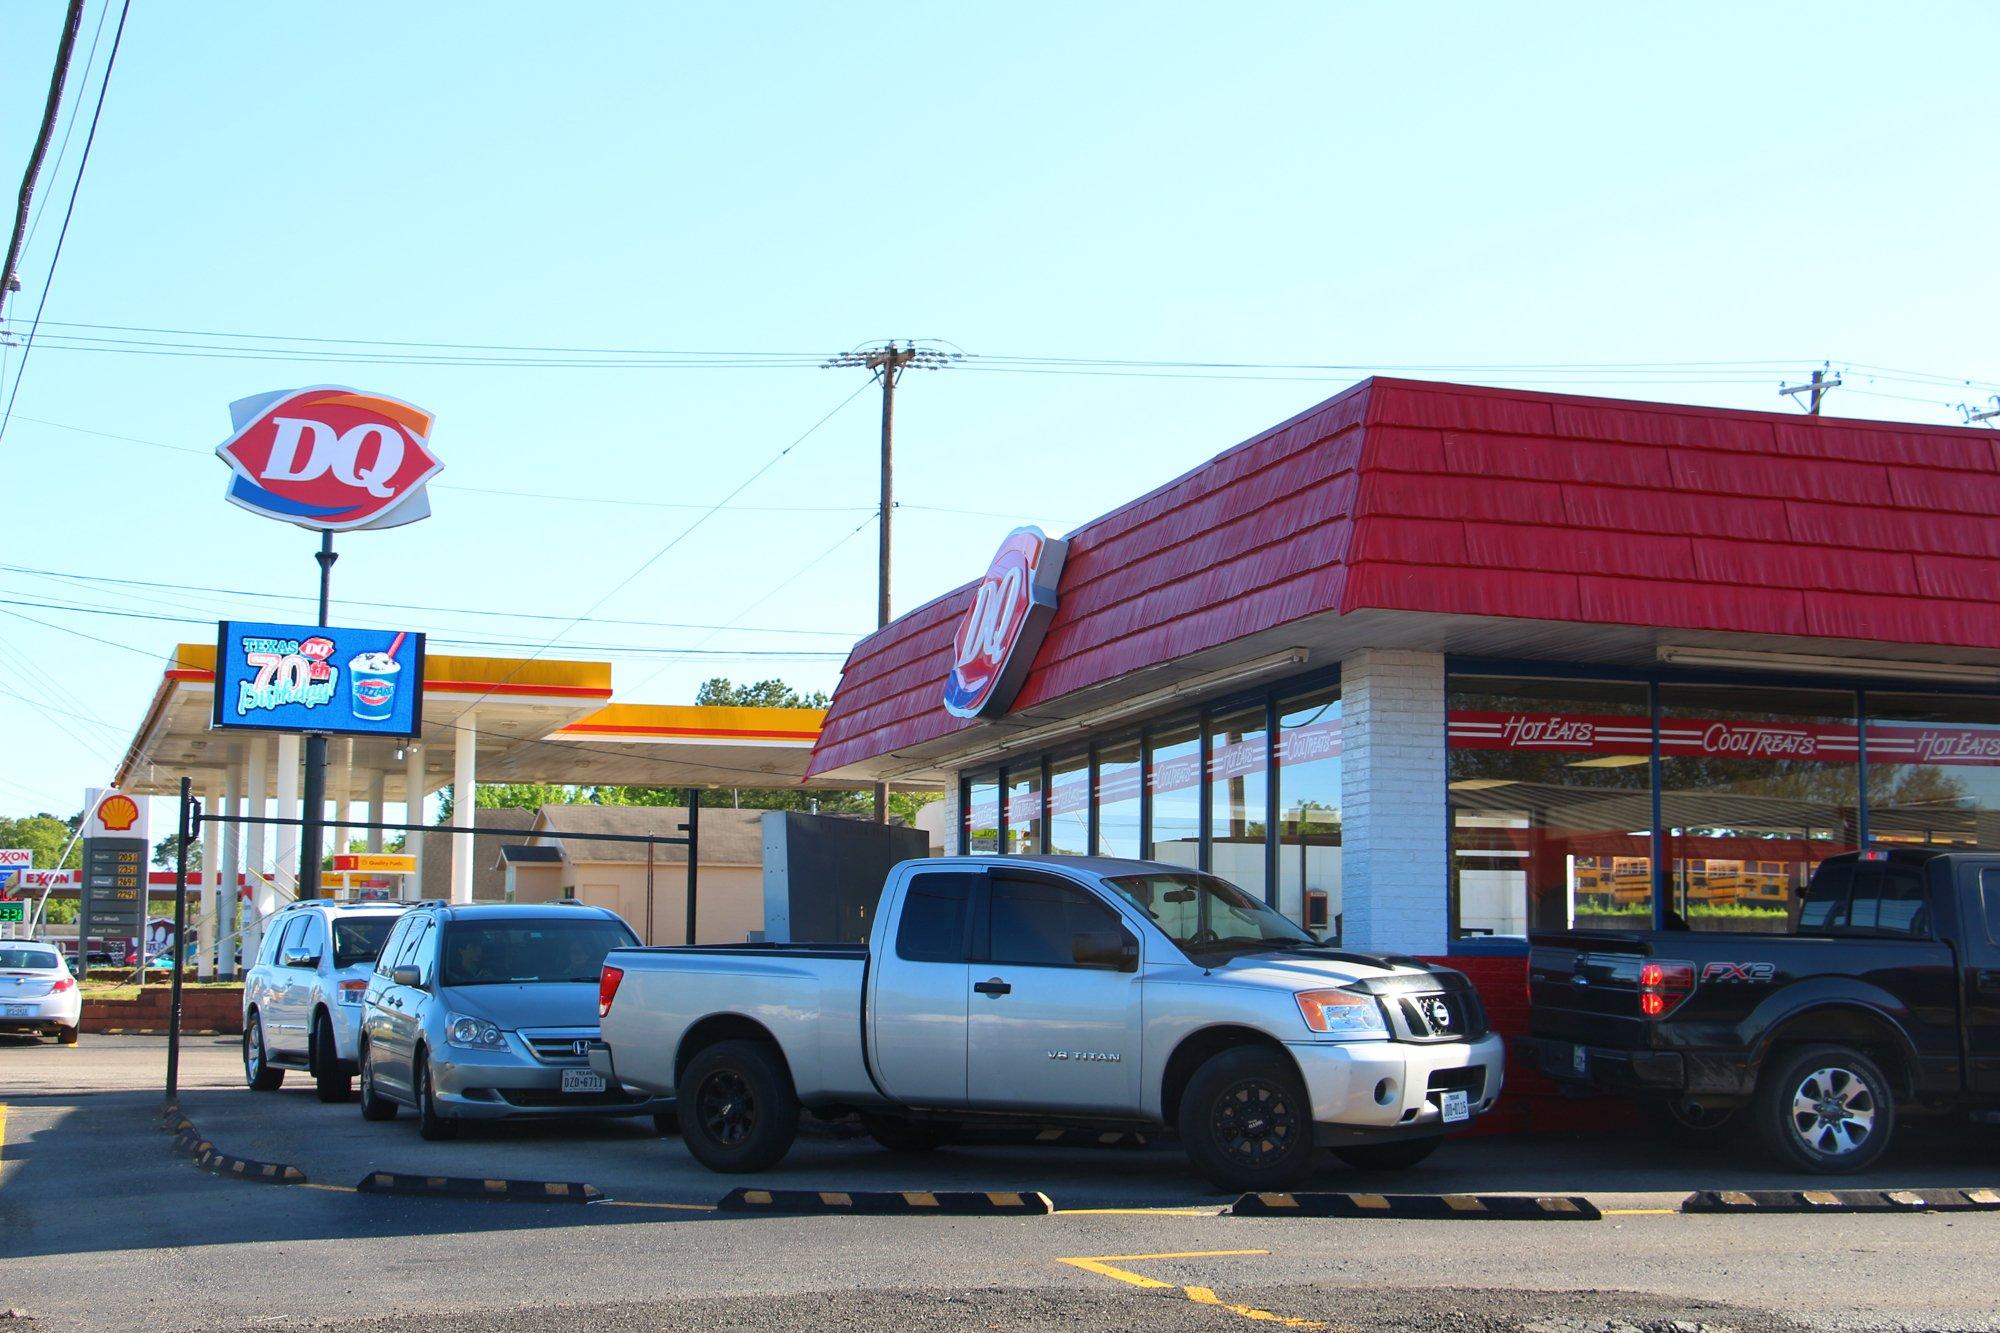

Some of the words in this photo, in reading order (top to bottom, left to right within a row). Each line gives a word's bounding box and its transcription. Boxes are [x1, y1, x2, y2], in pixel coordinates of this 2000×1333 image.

[260, 416, 405, 498] DQ
[957, 567, 1023, 665] DQ
[244, 638, 299, 655] TEXAS
[305, 643, 329, 655] DQ
[247, 653, 311, 693] 70
[311, 661, 331, 679] th
[0, 851, 29, 864] XXON
[26, 872, 70, 887] EXXON
[1701, 962, 1776, 980] FX2
[1047, 1051, 1069, 1060] V8
[1073, 1052, 1121, 1063] TITAN
